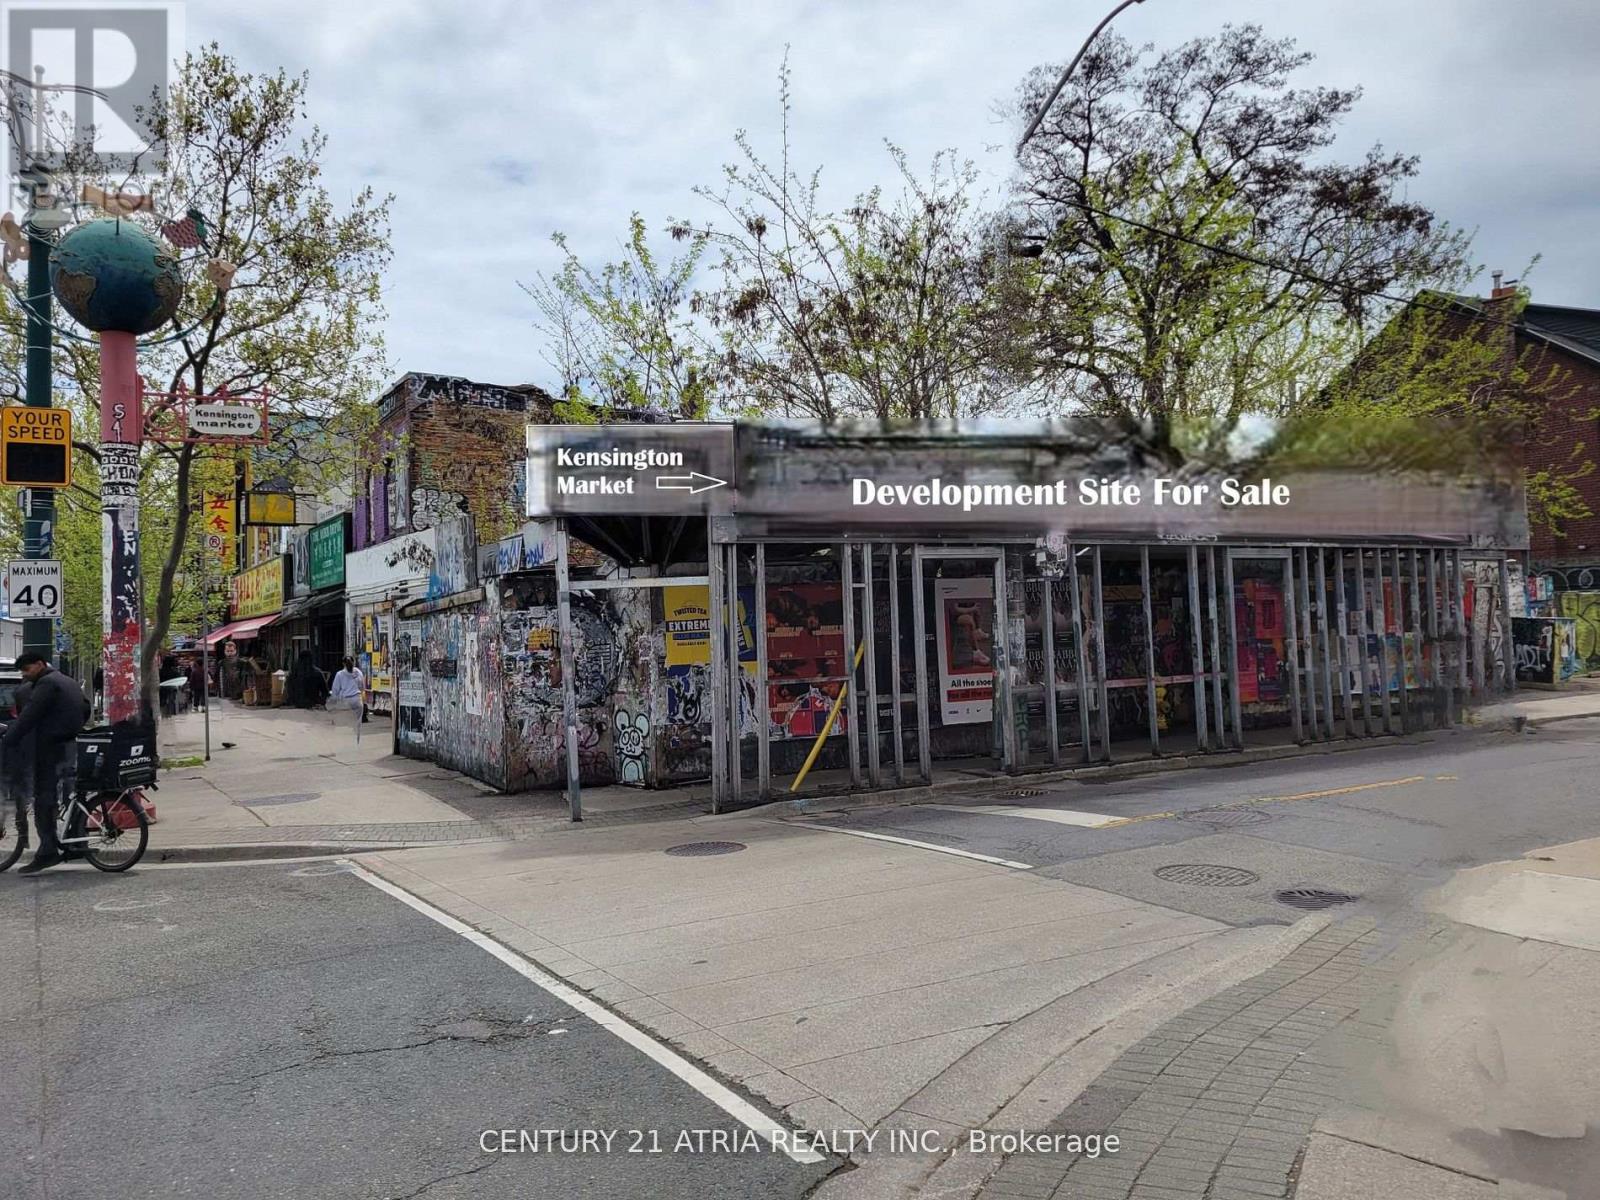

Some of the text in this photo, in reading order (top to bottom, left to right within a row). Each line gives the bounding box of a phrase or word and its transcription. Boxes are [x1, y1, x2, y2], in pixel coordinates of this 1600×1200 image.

[12, 411, 62, 426] YOUR
[195, 409, 255, 420] Kensington
[197, 420, 254, 429] market
[8, 425, 65, 440] SPEED
[12, 566, 58, 576] MAXIMUM
[12, 585, 58, 609] 40
[669, 620, 711, 631] EXTREM
[951, 678, 992, 687] All the shoe
